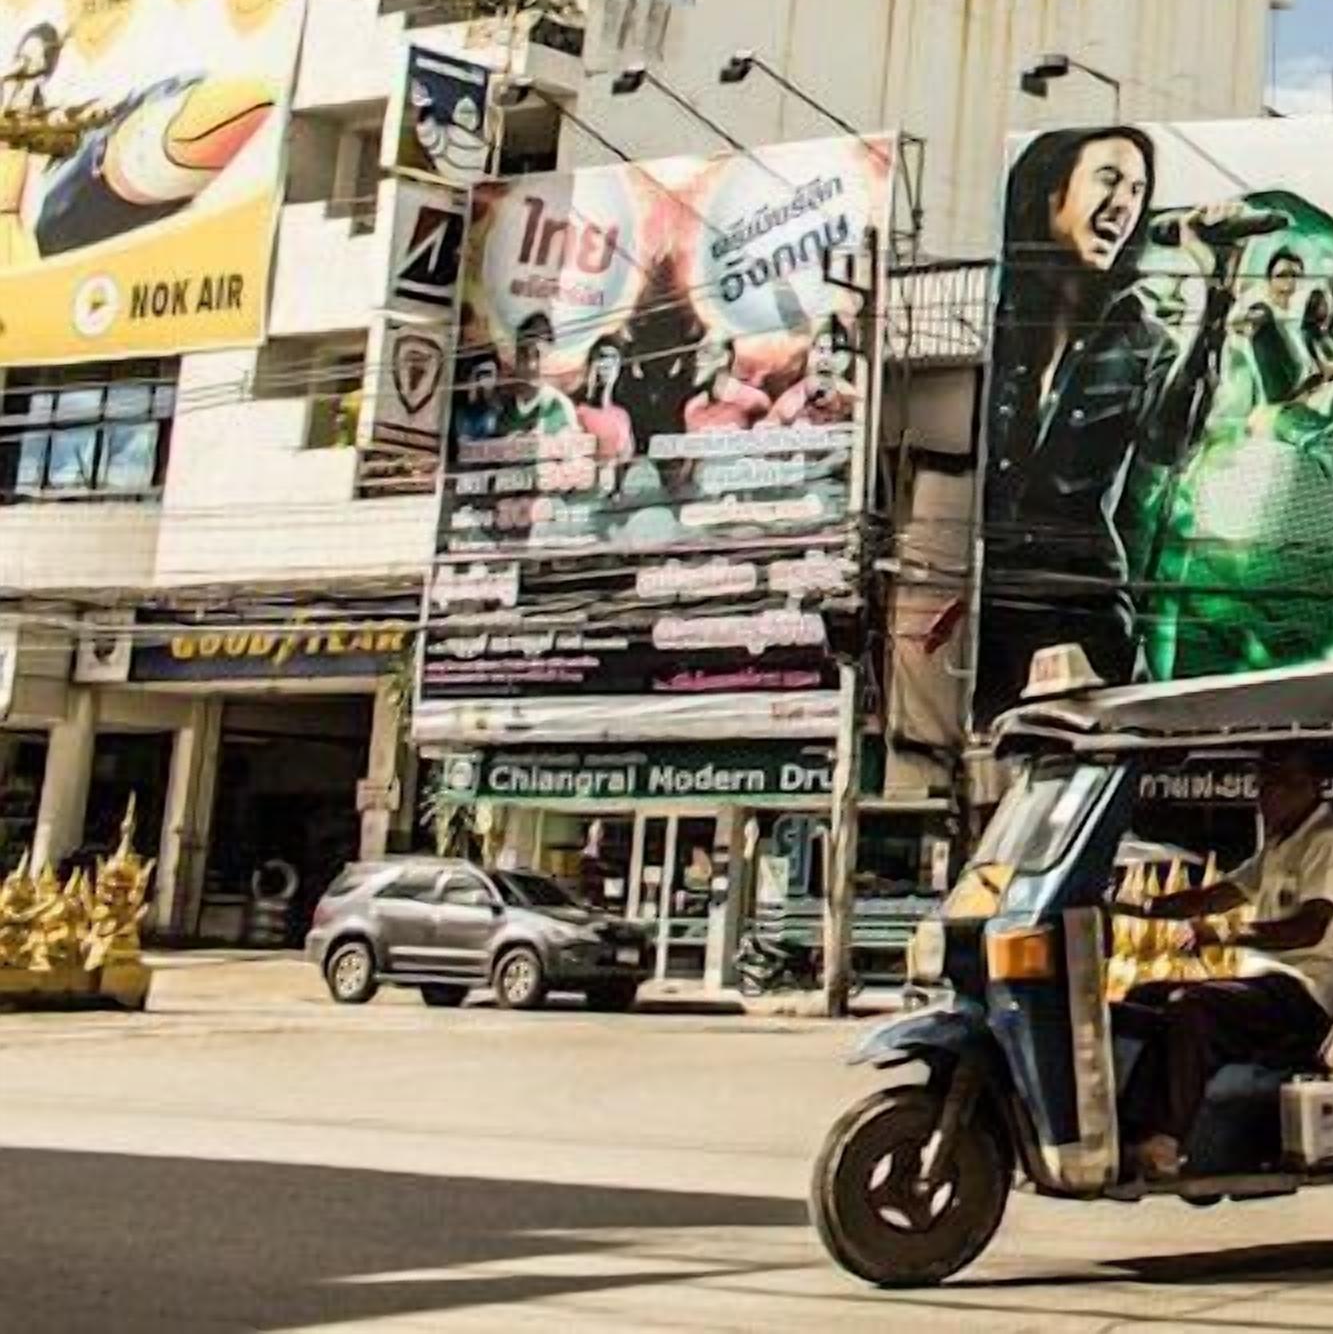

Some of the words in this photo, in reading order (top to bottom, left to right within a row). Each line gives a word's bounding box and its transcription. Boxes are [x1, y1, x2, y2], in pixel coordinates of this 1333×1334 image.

[518, 196, 619, 274] ไทย
[130, 278, 191, 319] NOK
[196, 273, 244, 314] AIR
[488, 765, 636, 797] Chiangrai
[648, 764, 765, 793] Modern
[779, 764, 834, 792] Dru
